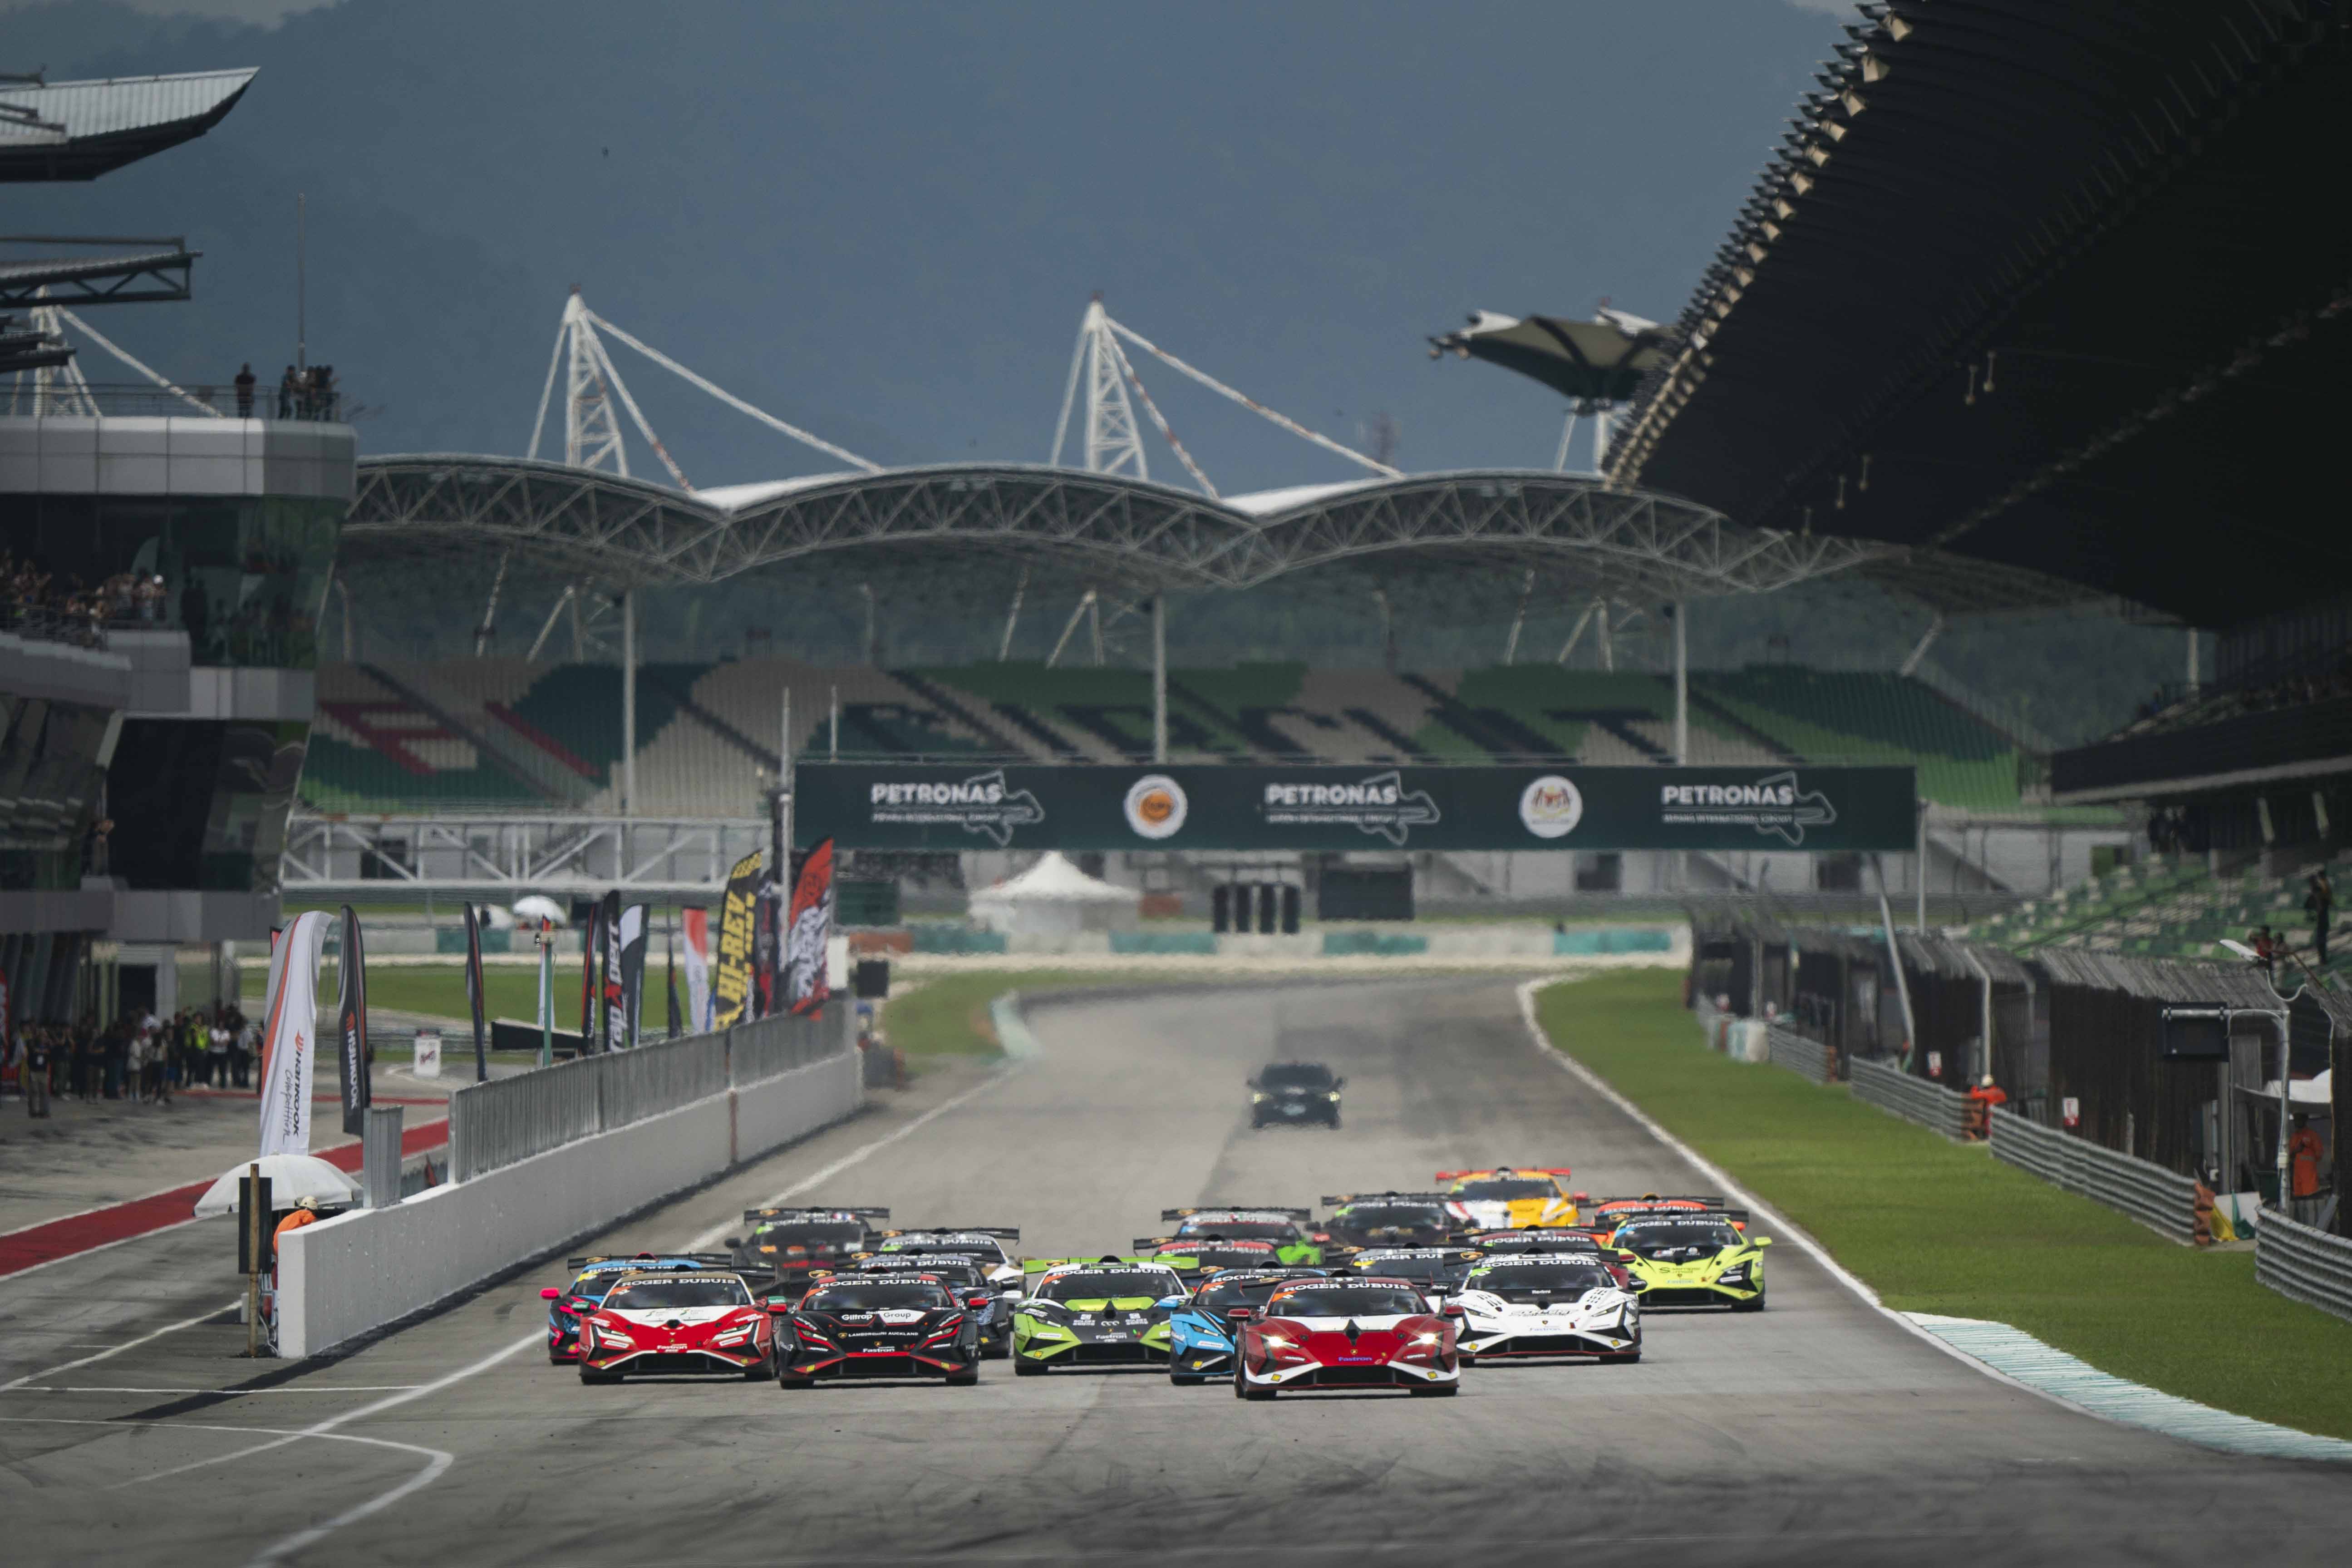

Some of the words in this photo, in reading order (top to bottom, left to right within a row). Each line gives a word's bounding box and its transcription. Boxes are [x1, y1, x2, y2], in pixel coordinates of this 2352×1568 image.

[871, 783, 1003, 805] PETRONAS
[1265, 783, 1397, 805] PETRONAS
[1661, 785, 1793, 805] PETRONAS
[719, 891, 747, 1000] HI-REV
[861, 1261, 911, 1269] ROGER
[1481, 1260, 1534, 1268] ROGER
[621, 1278, 673, 1287] ROGER
[819, 1280, 872, 1288] ROGER
[1283, 1284, 1341, 1292] ROGER
